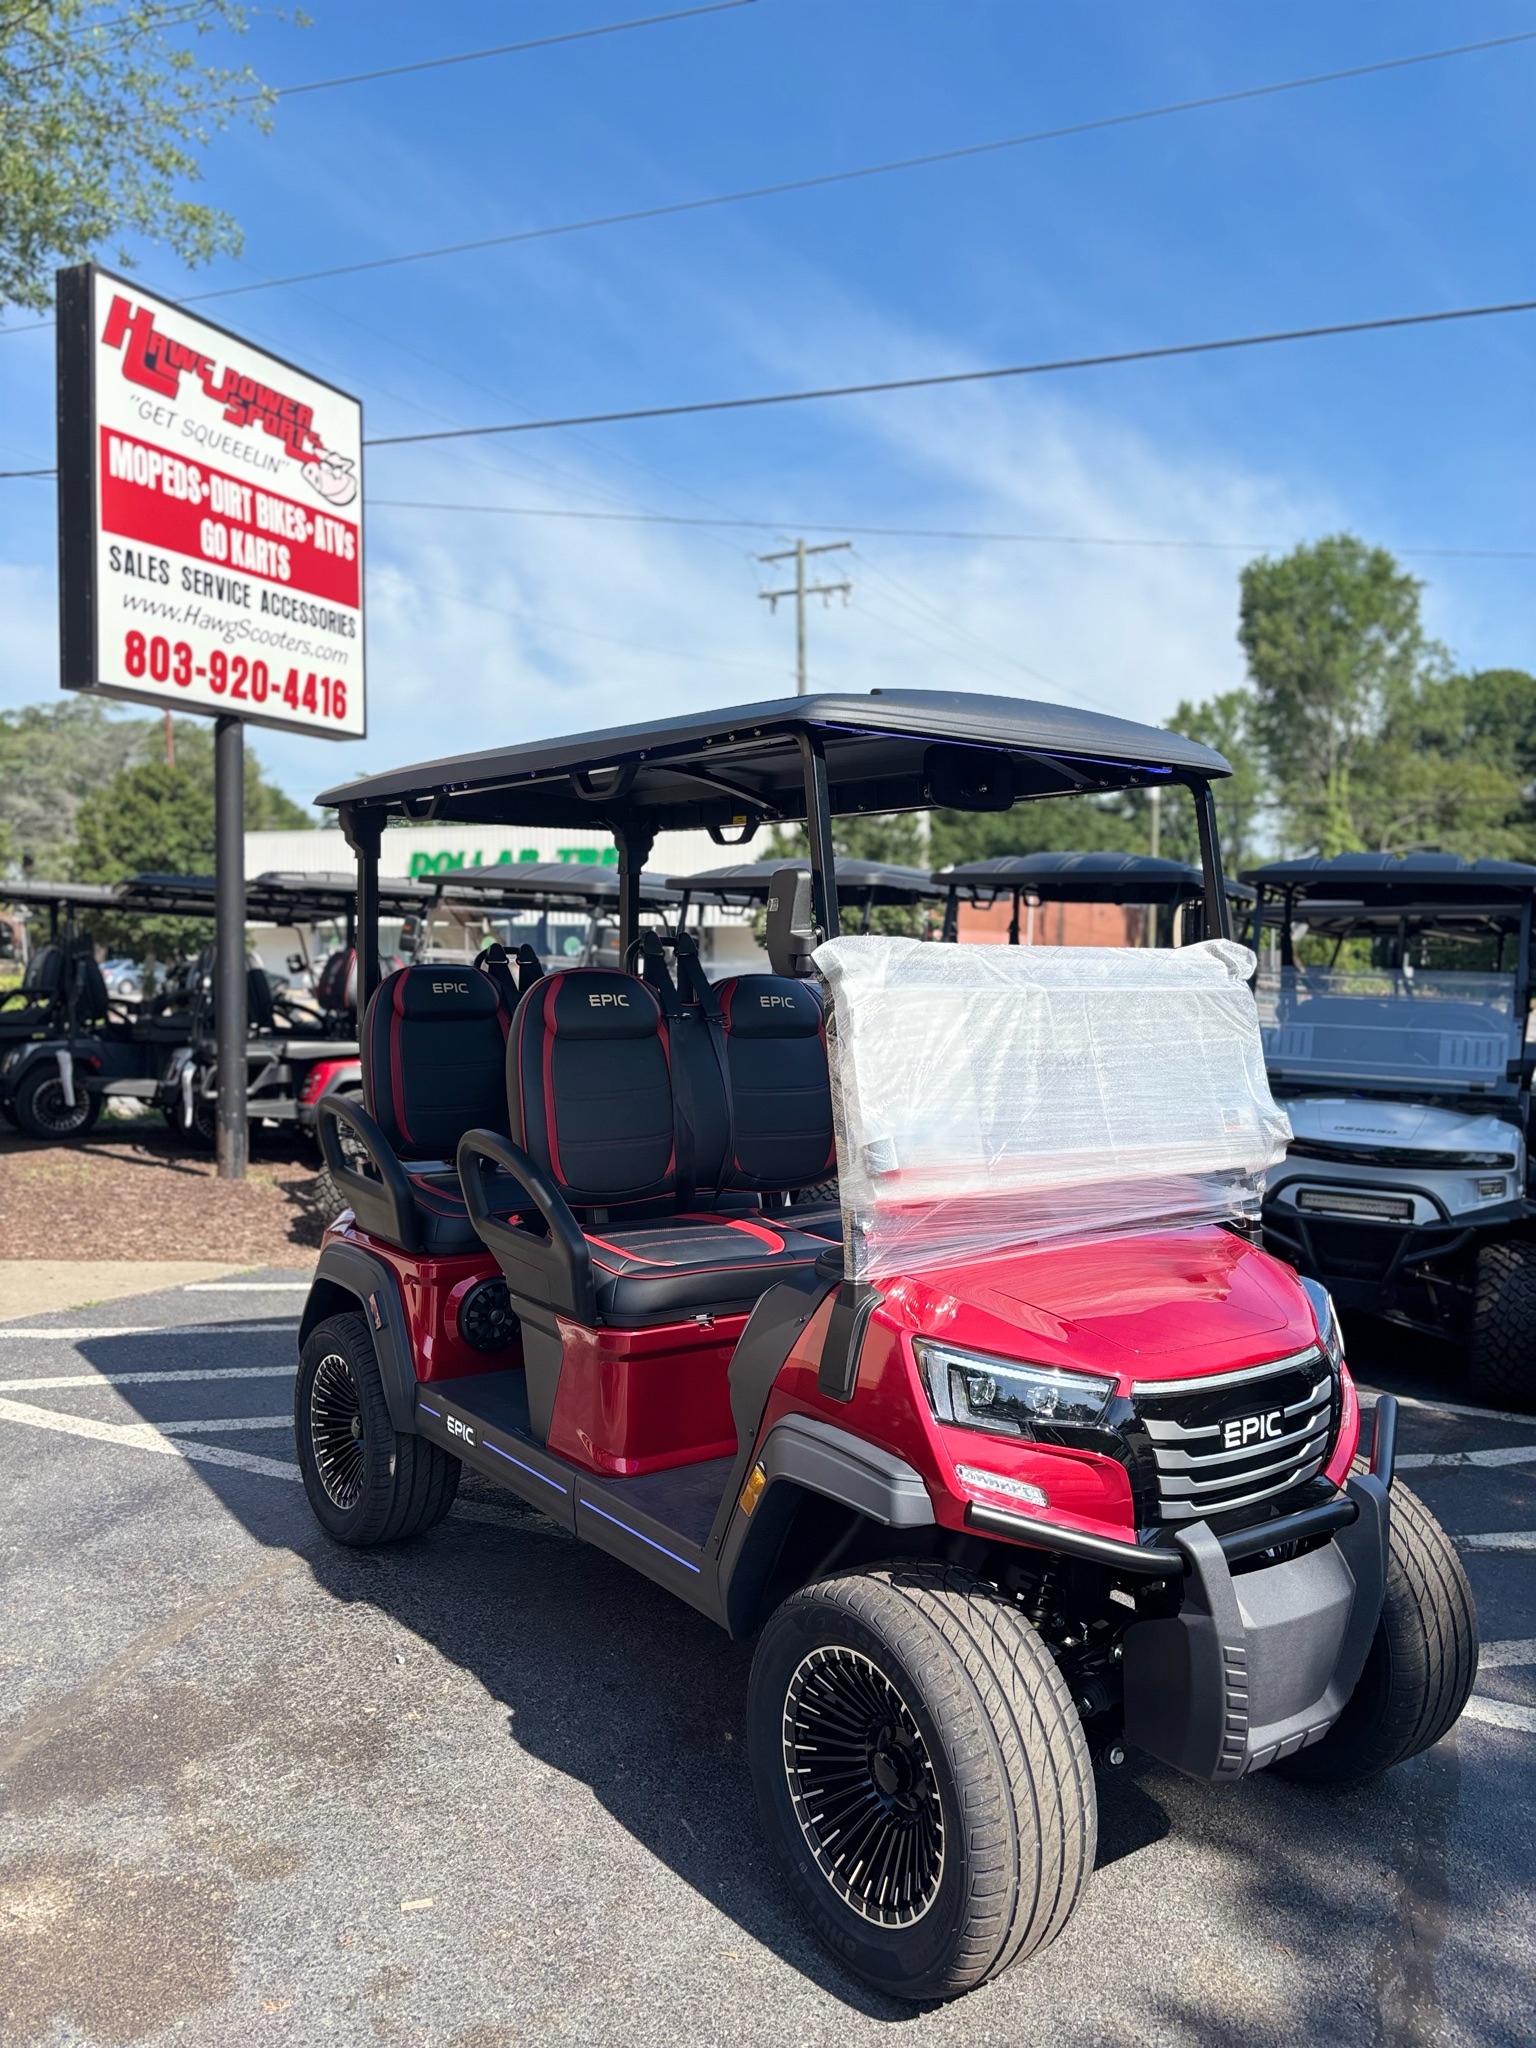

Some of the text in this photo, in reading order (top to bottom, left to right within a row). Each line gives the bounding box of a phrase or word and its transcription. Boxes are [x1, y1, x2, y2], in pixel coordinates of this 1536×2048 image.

[222, 366, 314, 432] POWER
[200, 518, 291, 581] GO KARTS
[109, 545, 356, 639] SALES SERVICE ACCESSORIES
[123, 594, 349, 665] www.HawgScooters.com
[125, 630, 347, 720] 803-920-4416
[432, 982, 469, 995] EPIC
[588, 993, 630, 1008] EPIC
[760, 995, 795, 1009] EPIC
[446, 1414, 475, 1447] EPIC
[1223, 1411, 1283, 1449] EPIC
